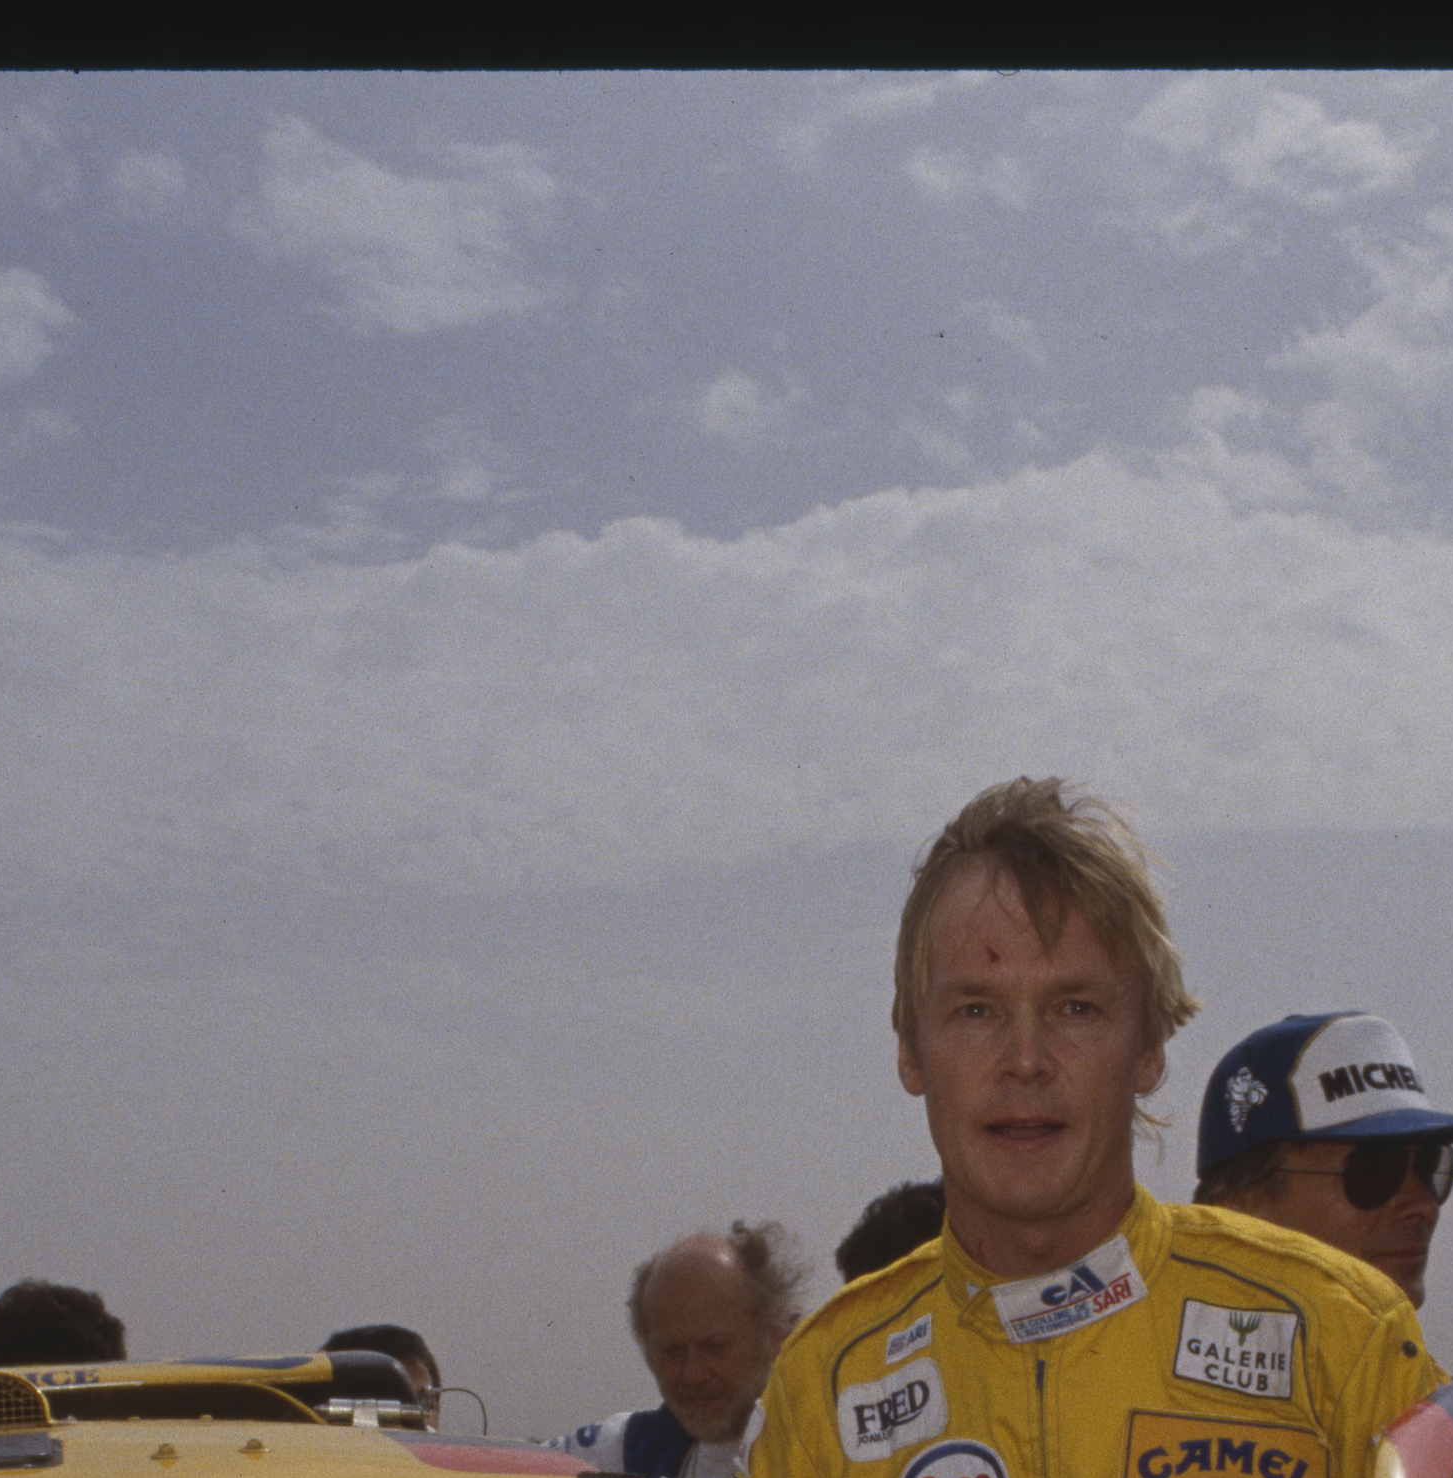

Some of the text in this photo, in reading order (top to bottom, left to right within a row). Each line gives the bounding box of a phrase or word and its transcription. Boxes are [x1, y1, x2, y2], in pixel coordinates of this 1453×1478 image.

[1092, 1278, 1133, 1314] SARI
[1186, 1337, 1287, 1372] GALERIE
[1204, 1362, 1269, 1392] CLUB
[853, 1379, 930, 1433] FRED
